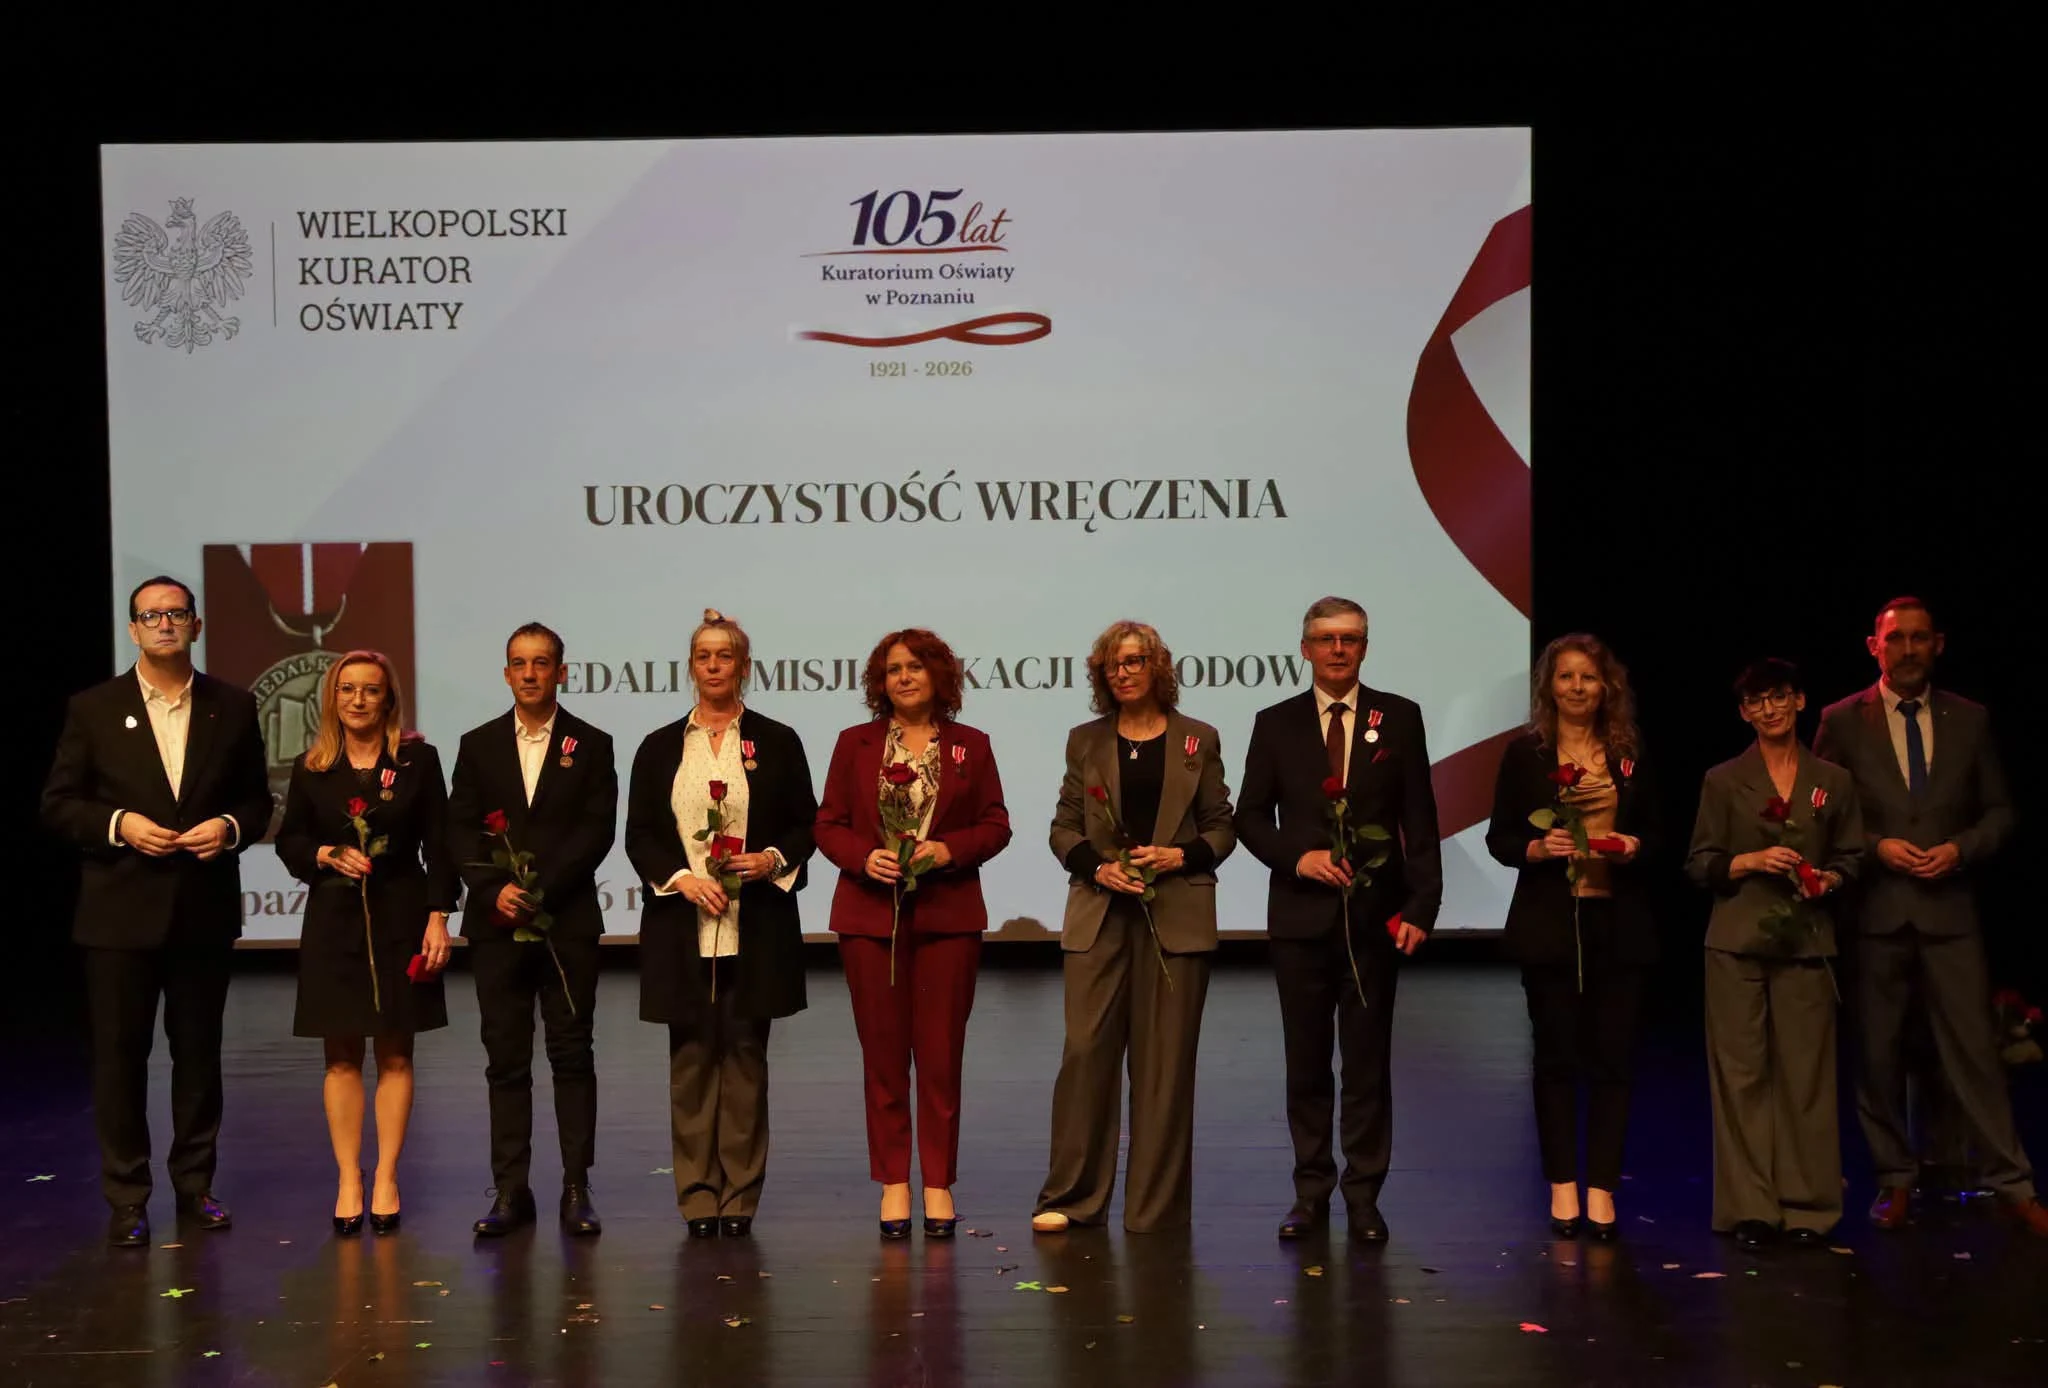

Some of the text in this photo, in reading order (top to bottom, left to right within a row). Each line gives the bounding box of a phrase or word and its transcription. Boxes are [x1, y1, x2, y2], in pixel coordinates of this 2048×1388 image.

[296, 208, 568, 240] WIELKOPOLSKI
[849, 188, 1013, 247] 105 lat
[298, 256, 472, 285] KURATOR
[821, 262, 1016, 284] Kuratorium Oświaty
[865, 288, 975, 306] w Poznaniu
[299, 296, 464, 332] OŚWIATY
[869, 362, 906, 377] 1921
[924, 360, 973, 377] 2026
[583, 471, 1288, 533] UROCZYSTOŚĆ WRĘCZENIA
[560, 661, 682, 694] EDALI
[752, 658, 859, 692] MISJI
[956, 656, 1075, 690] KACJI
